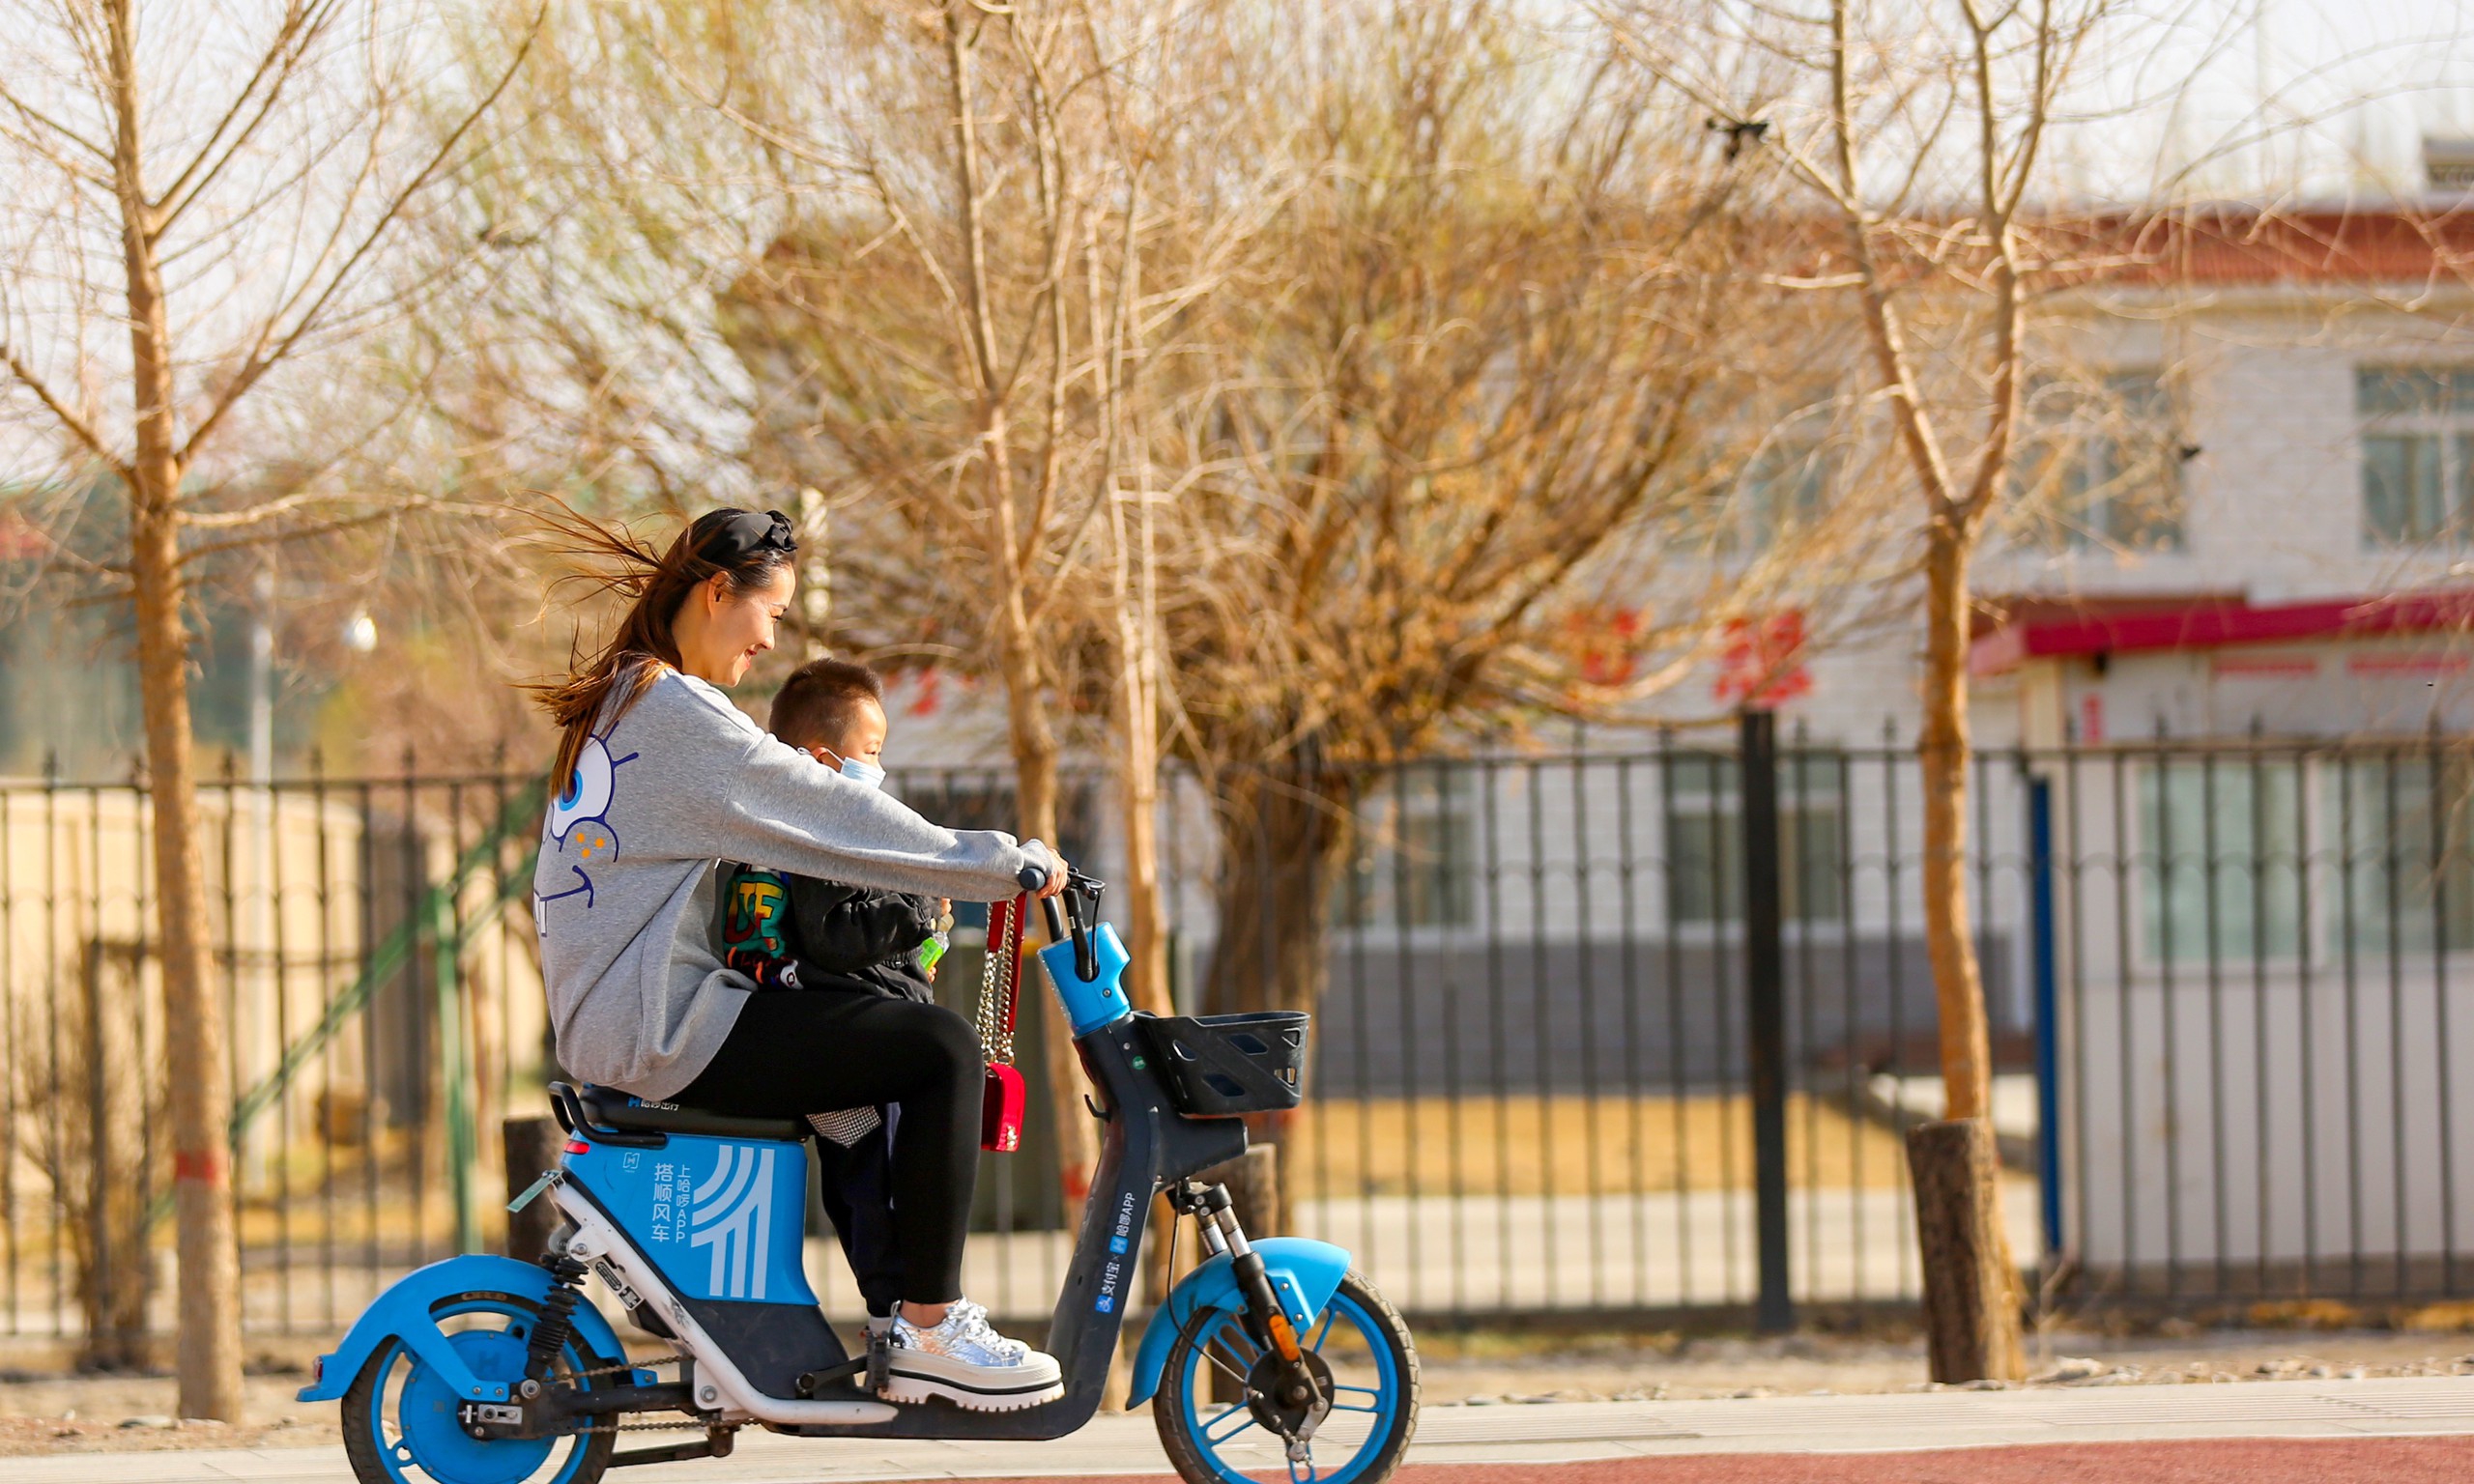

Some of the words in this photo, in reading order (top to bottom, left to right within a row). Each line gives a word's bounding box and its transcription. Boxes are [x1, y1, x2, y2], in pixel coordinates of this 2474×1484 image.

[651, 1163, 674, 1242] 搭顺风车
[676, 1164, 691, 1243] 上哈啰APP
[1102, 1262, 1120, 1296] 支付宝
